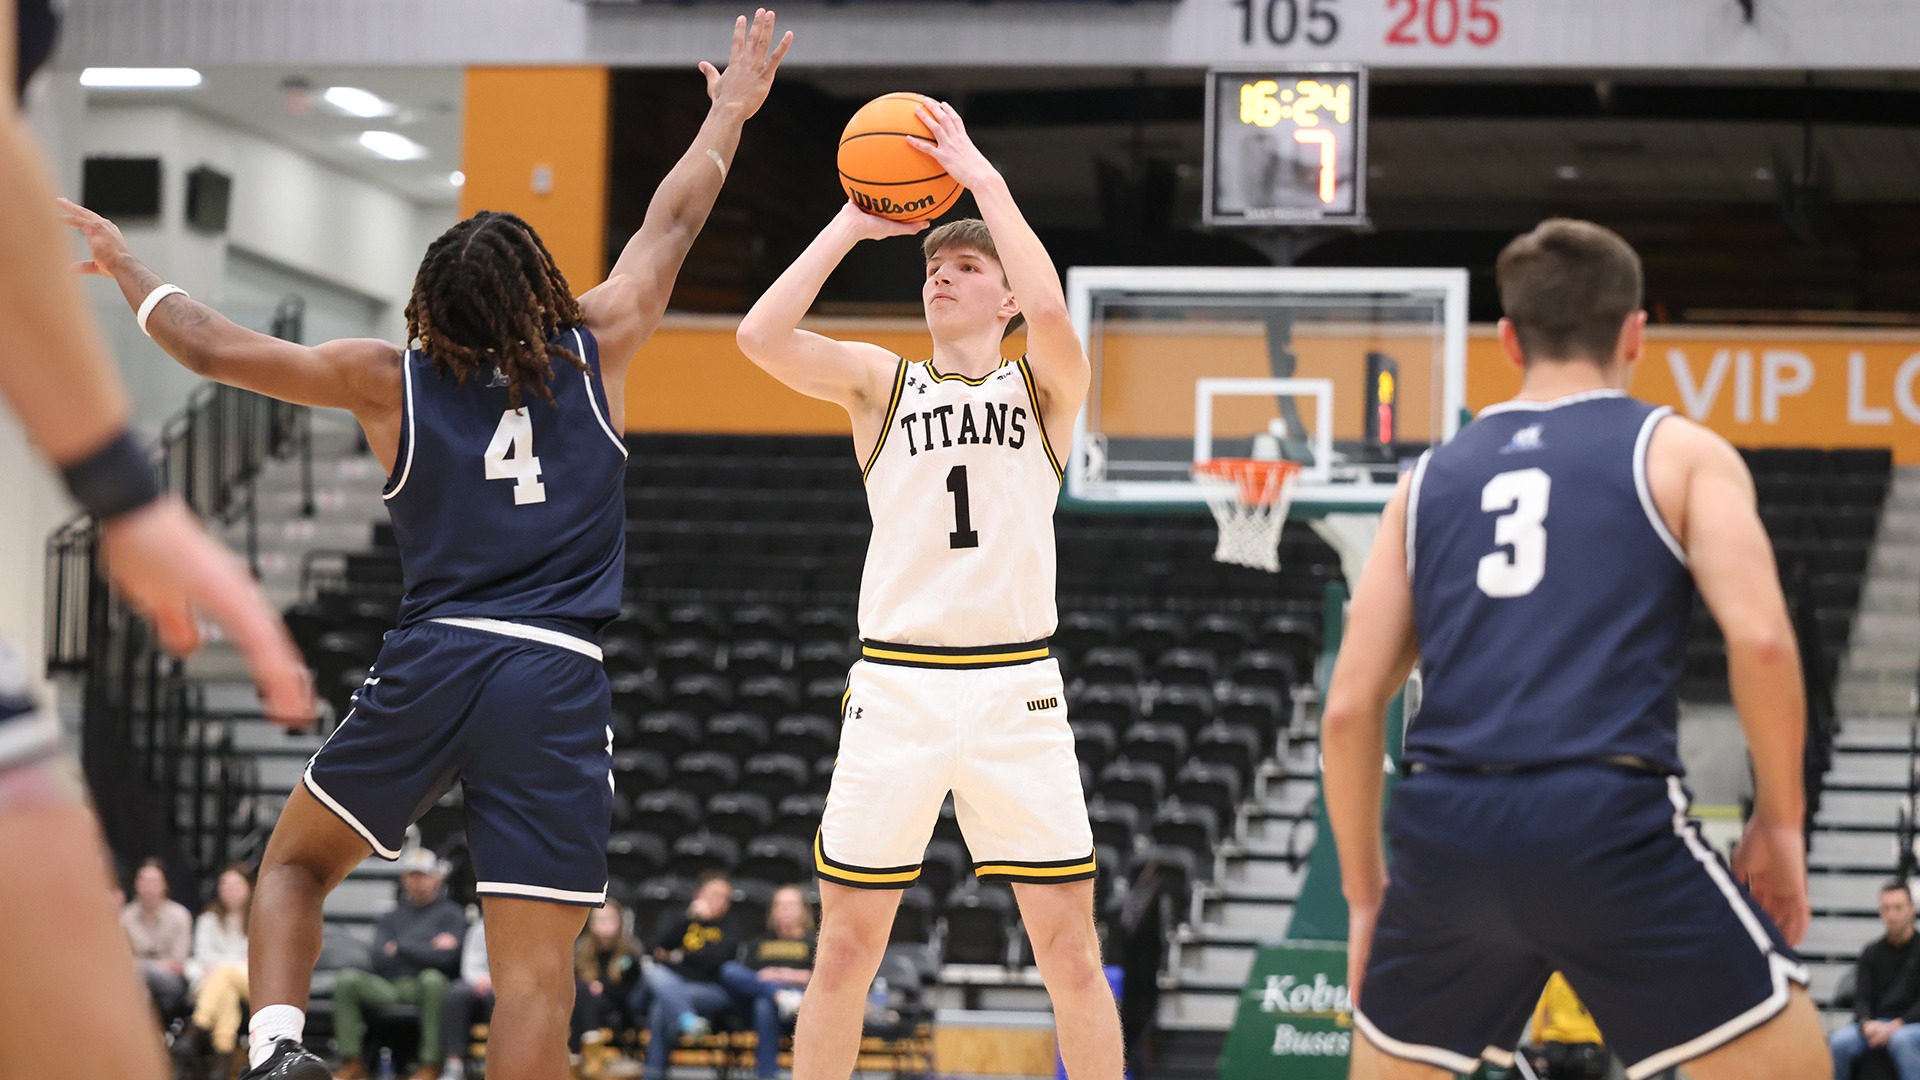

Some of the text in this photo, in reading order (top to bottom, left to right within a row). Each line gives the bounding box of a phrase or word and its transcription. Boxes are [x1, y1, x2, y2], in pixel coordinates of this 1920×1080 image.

[1234, 0, 1340, 46] 105
[1384, 0, 1502, 47] 205
[1240, 80, 1350, 127] 16:24
[1293, 128, 1336, 204] 7
[849, 187, 936, 214] Wilson
[1667, 350, 1815, 424] VIP
[484, 406, 546, 505] 4
[901, 402, 1027, 456] TITANS
[946, 465, 979, 549] 1
[1476, 467, 1551, 598] 3
[1272, 1023, 1351, 1055] Buses
